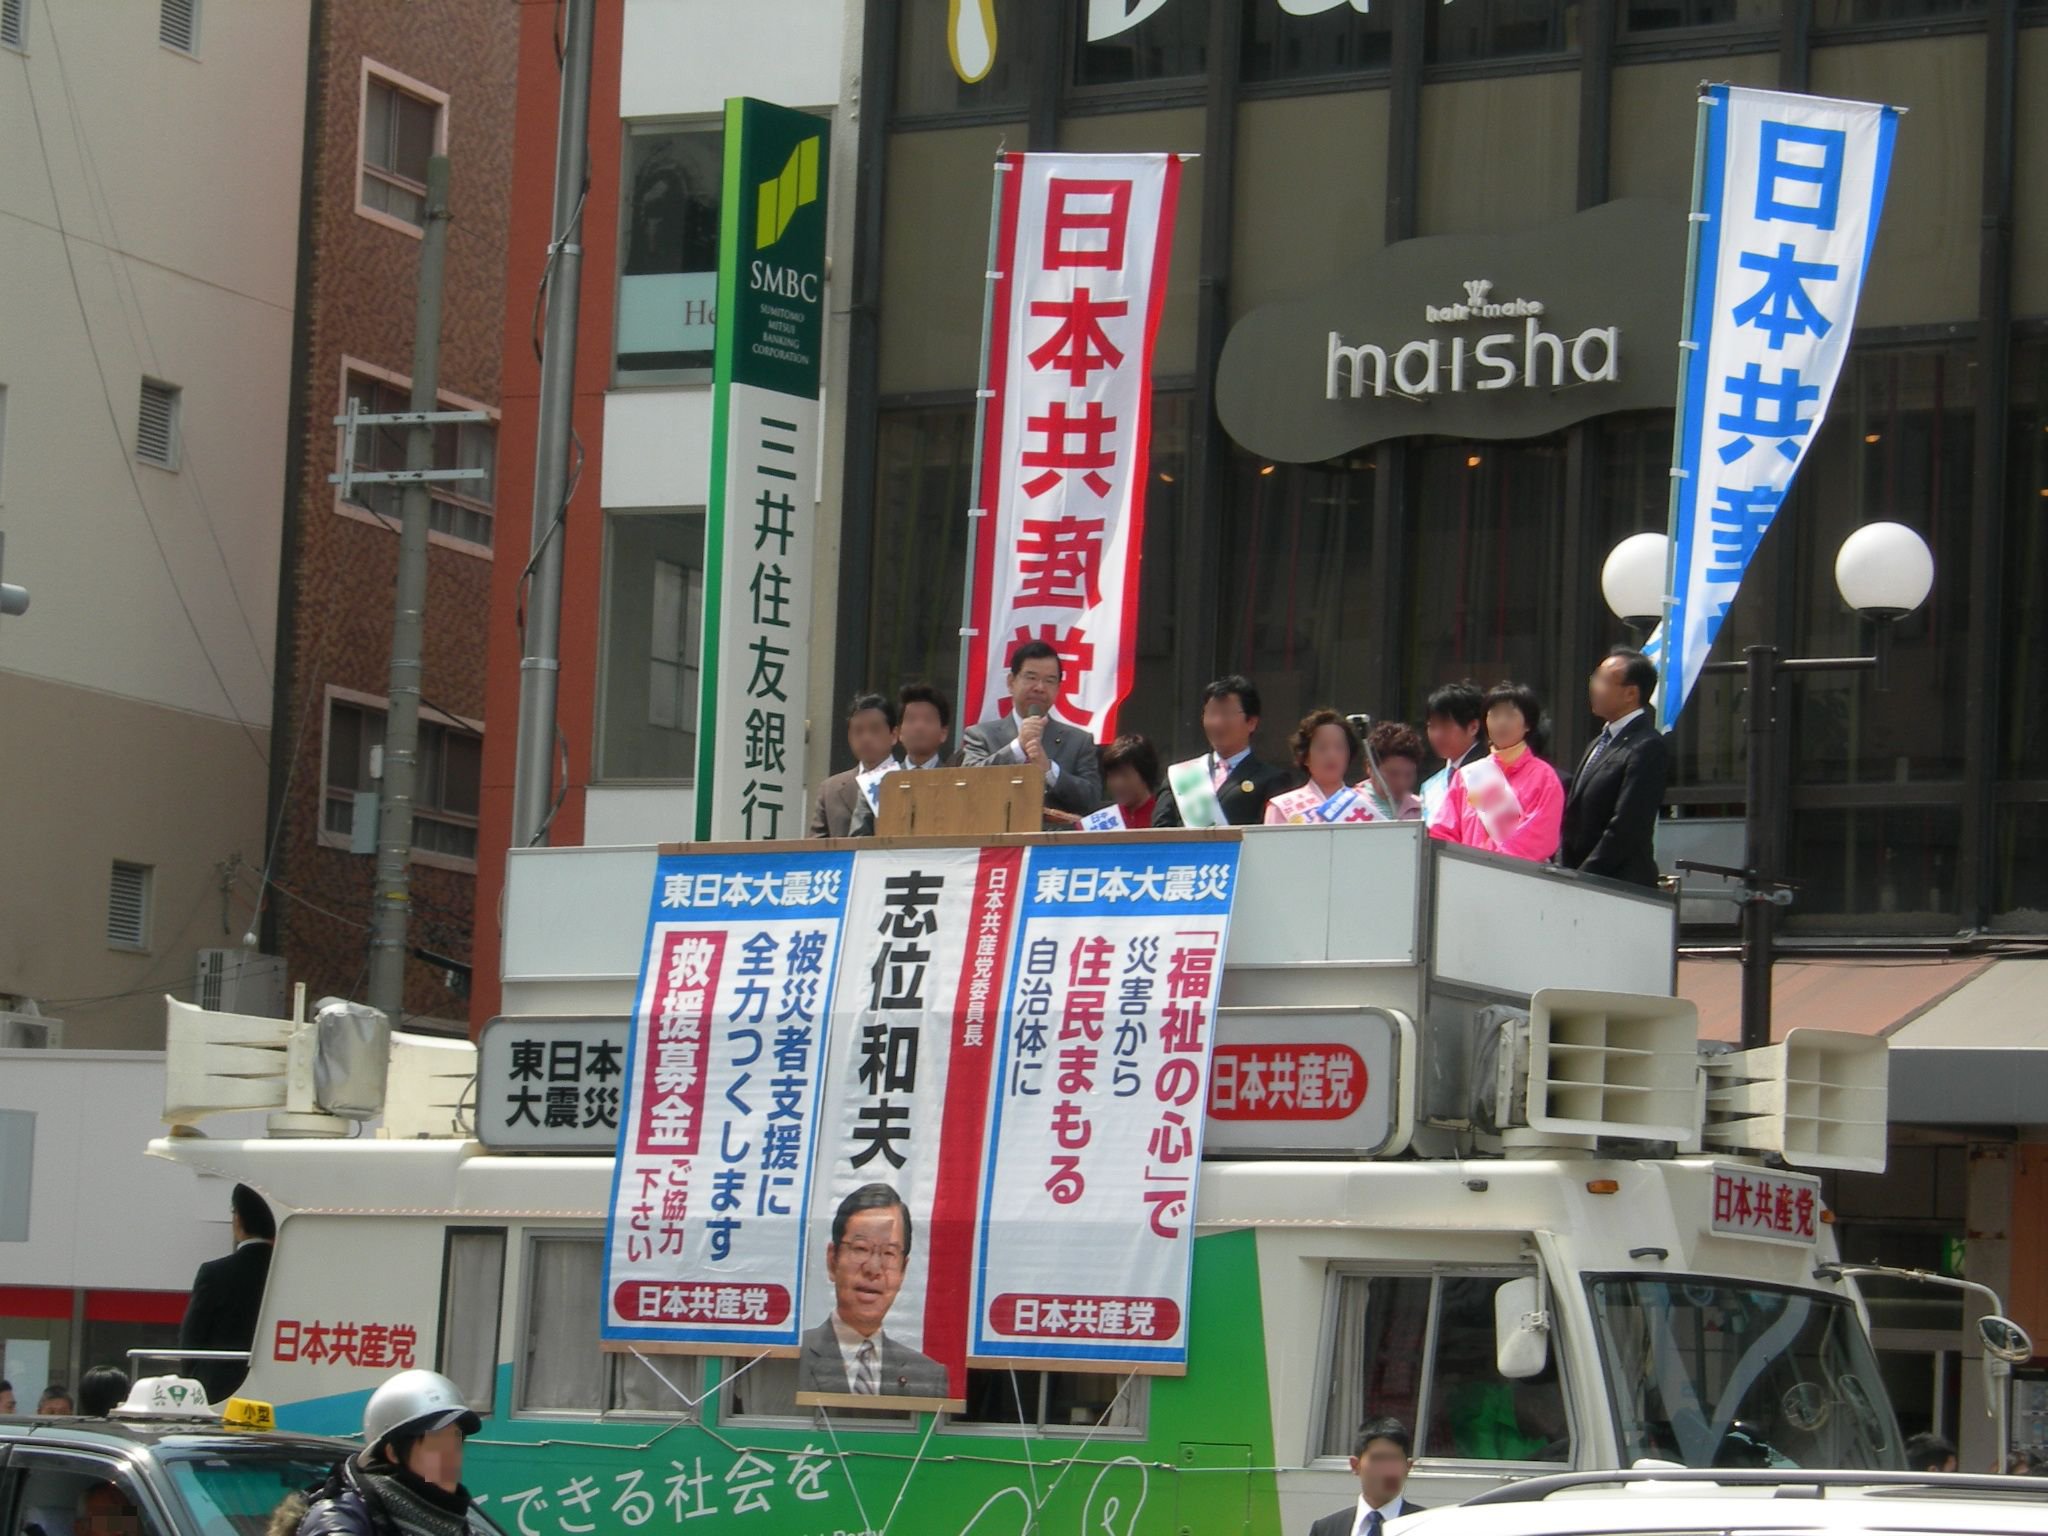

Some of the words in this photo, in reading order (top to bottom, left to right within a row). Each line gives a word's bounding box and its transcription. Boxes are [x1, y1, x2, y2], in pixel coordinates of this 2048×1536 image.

[750, 260, 818, 303] SMBC
[1426, 303, 1469, 323] hair
[1482, 298, 1544, 318] make
[760, 304, 805, 323] SUMITOMO
[763, 332, 800, 349] BANKING
[768, 319, 796, 335] MITSUI
[752, 343, 809, 365] CORPORATION
[1326, 317, 1619, 400] maisha
[740, 416, 798, 840] 三井住友銀行
[661, 869, 842, 908] 東日本大震災
[1034, 863, 1230, 904] 東日本大震災
[963, 867, 1009, 1047] 日本共産党委員長
[647, 937, 716, 1147] 救援募金
[849, 870, 945, 1170] 志位和夫
[1011, 936, 1058, 1096] 自治体に
[1113, 936, 1160, 1097] 災害から
[508, 1039, 623, 1082] 東日本
[757, 930, 828, 1216] 被災者支援に
[1044, 936, 1115, 1205] 住民まもる
[1143, 931, 1219, 1239] 「福祉の心」で
[1212, 1052, 1354, 1110] 日本共産党
[505, 1085, 619, 1129] 大震災
[706, 932, 779, 1261] 全力つくします
[628, 1168, 661, 1262] 下さい
[658, 1159, 692, 1255] ご協力
[1714, 1174, 1814, 1237] 日本共産党
[638, 1286, 768, 1320] 日本共産党
[1013, 1299, 1156, 1336] 日本共産党
[274, 1319, 416, 1368] 日本共産党
[470, 1443, 833, 1536] できる社会を
